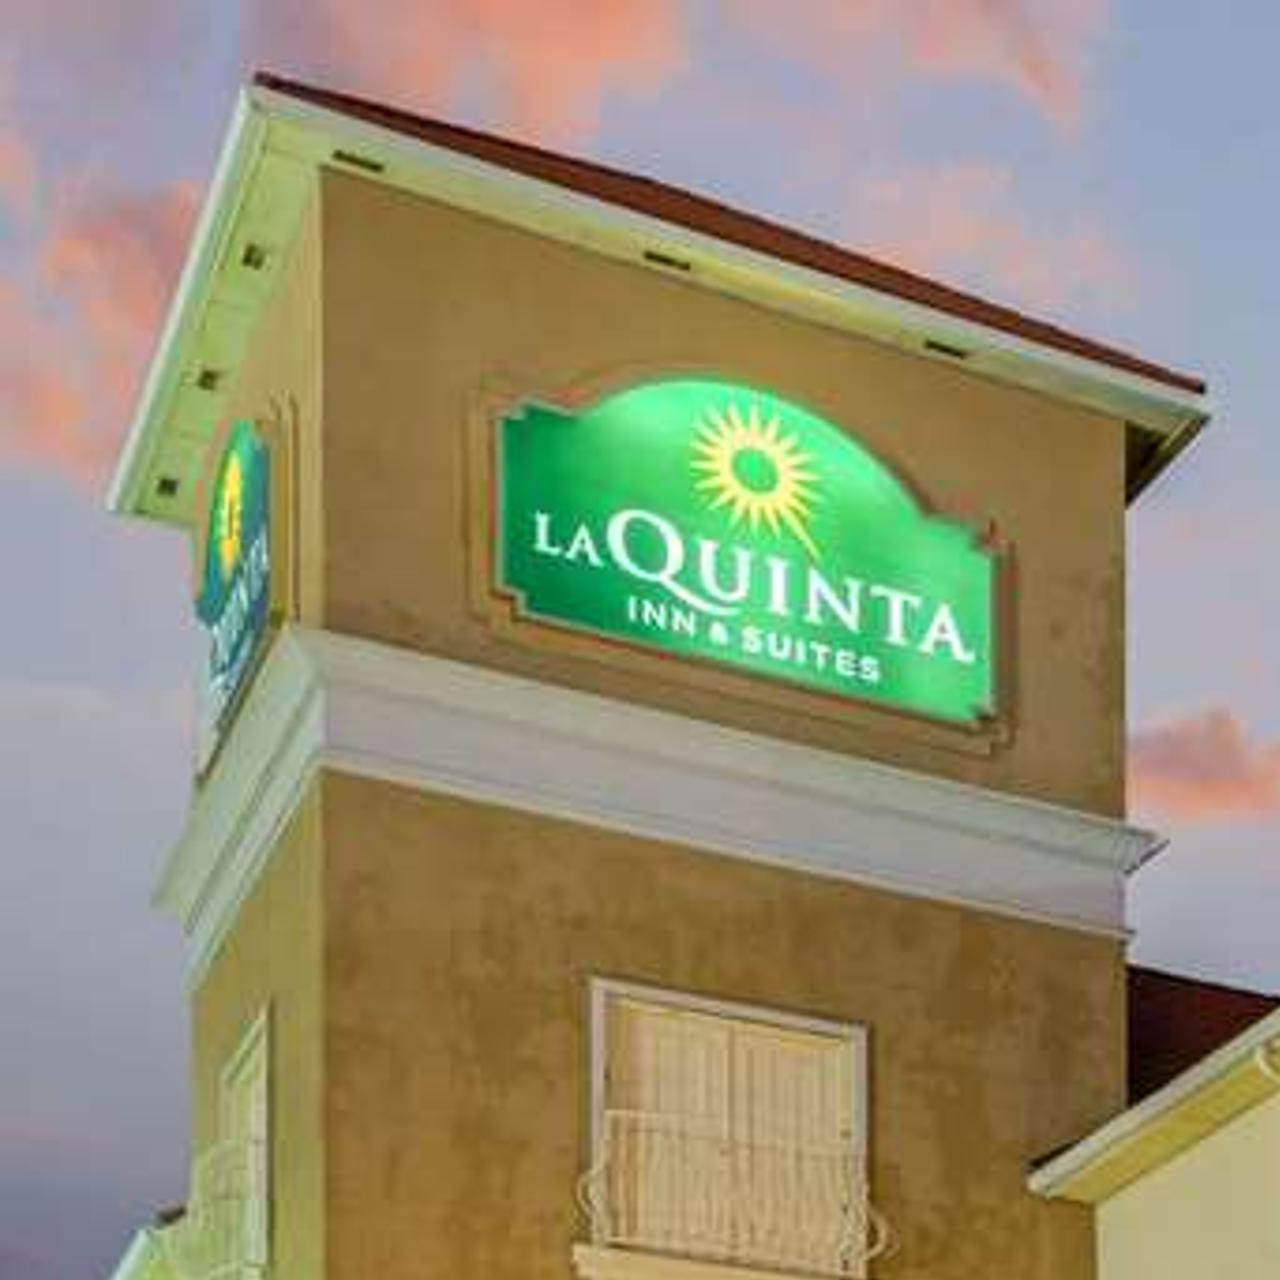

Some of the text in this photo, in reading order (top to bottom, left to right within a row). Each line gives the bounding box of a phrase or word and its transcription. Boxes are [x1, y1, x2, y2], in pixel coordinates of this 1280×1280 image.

[534, 508, 975, 663] LA QUINTA
[628, 595, 881, 683] INN & SUITES
